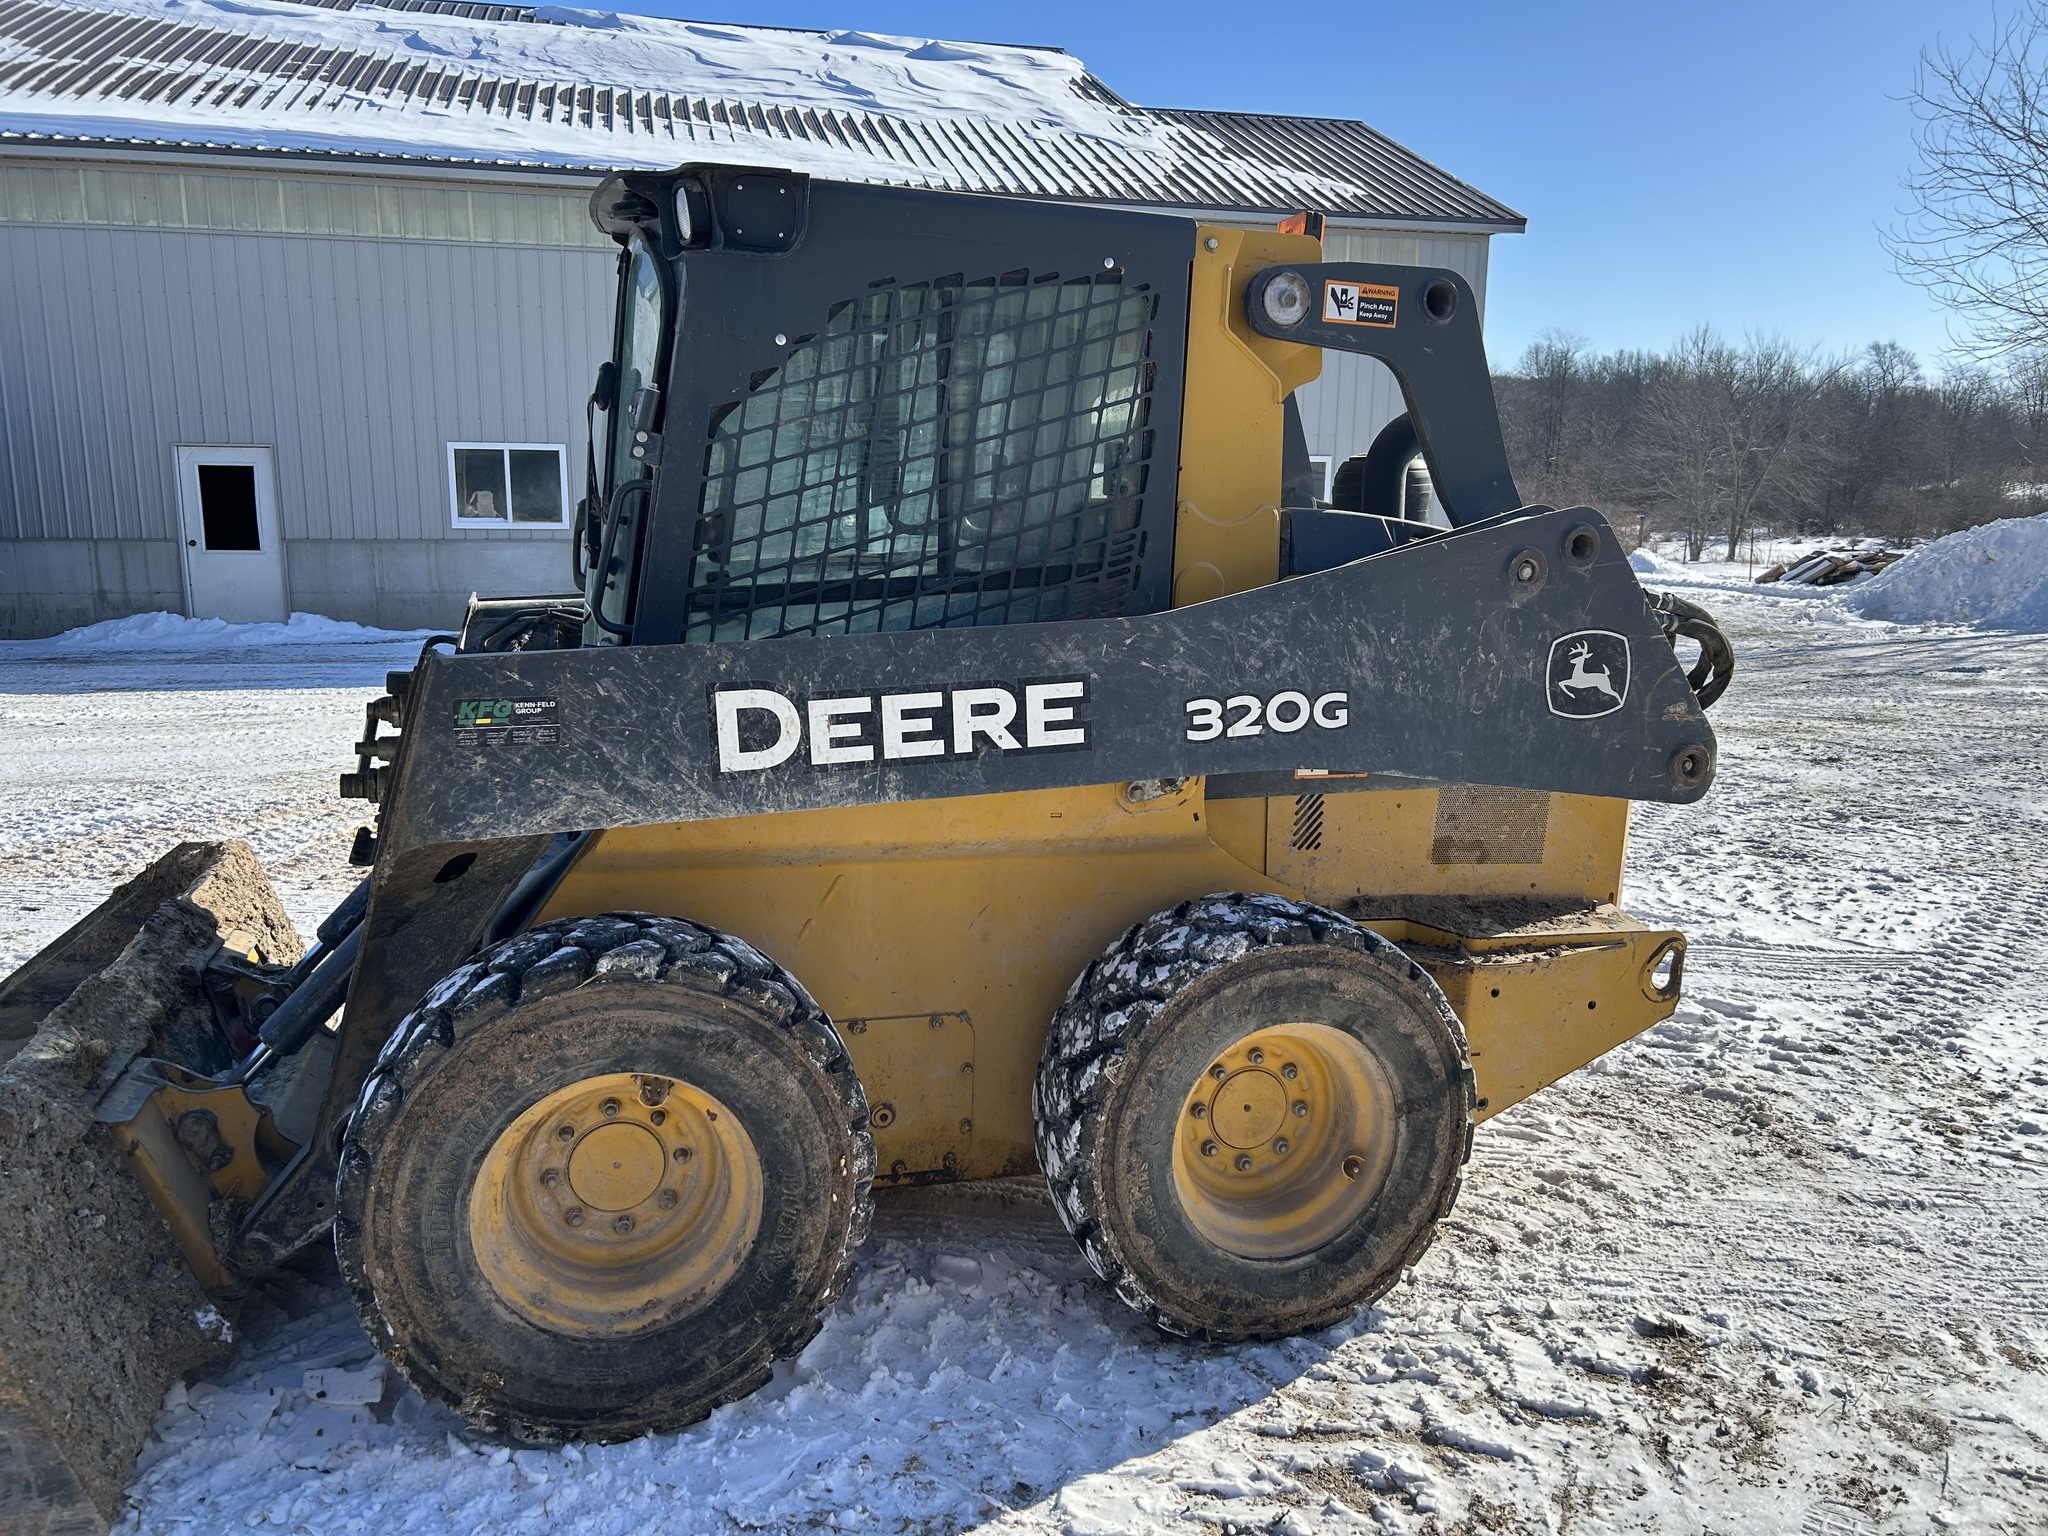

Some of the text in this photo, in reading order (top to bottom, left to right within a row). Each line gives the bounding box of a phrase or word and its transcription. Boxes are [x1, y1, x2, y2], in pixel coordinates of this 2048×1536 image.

[1368, 288, 1395, 296] WARNING
[1360, 302, 1393, 312] Pinch Area
[1359, 311, 1388, 320] Keep Away
[459, 700, 513, 719] KFG
[515, 701, 556, 709] KENN-FELD
[515, 707, 542, 715] GROUP
[1185, 691, 1349, 742] 320G
[714, 681, 1086, 774] DEERE
[1158, 1022, 1224, 1101] TITAN
[426, 1154, 464, 1256] TITAN
